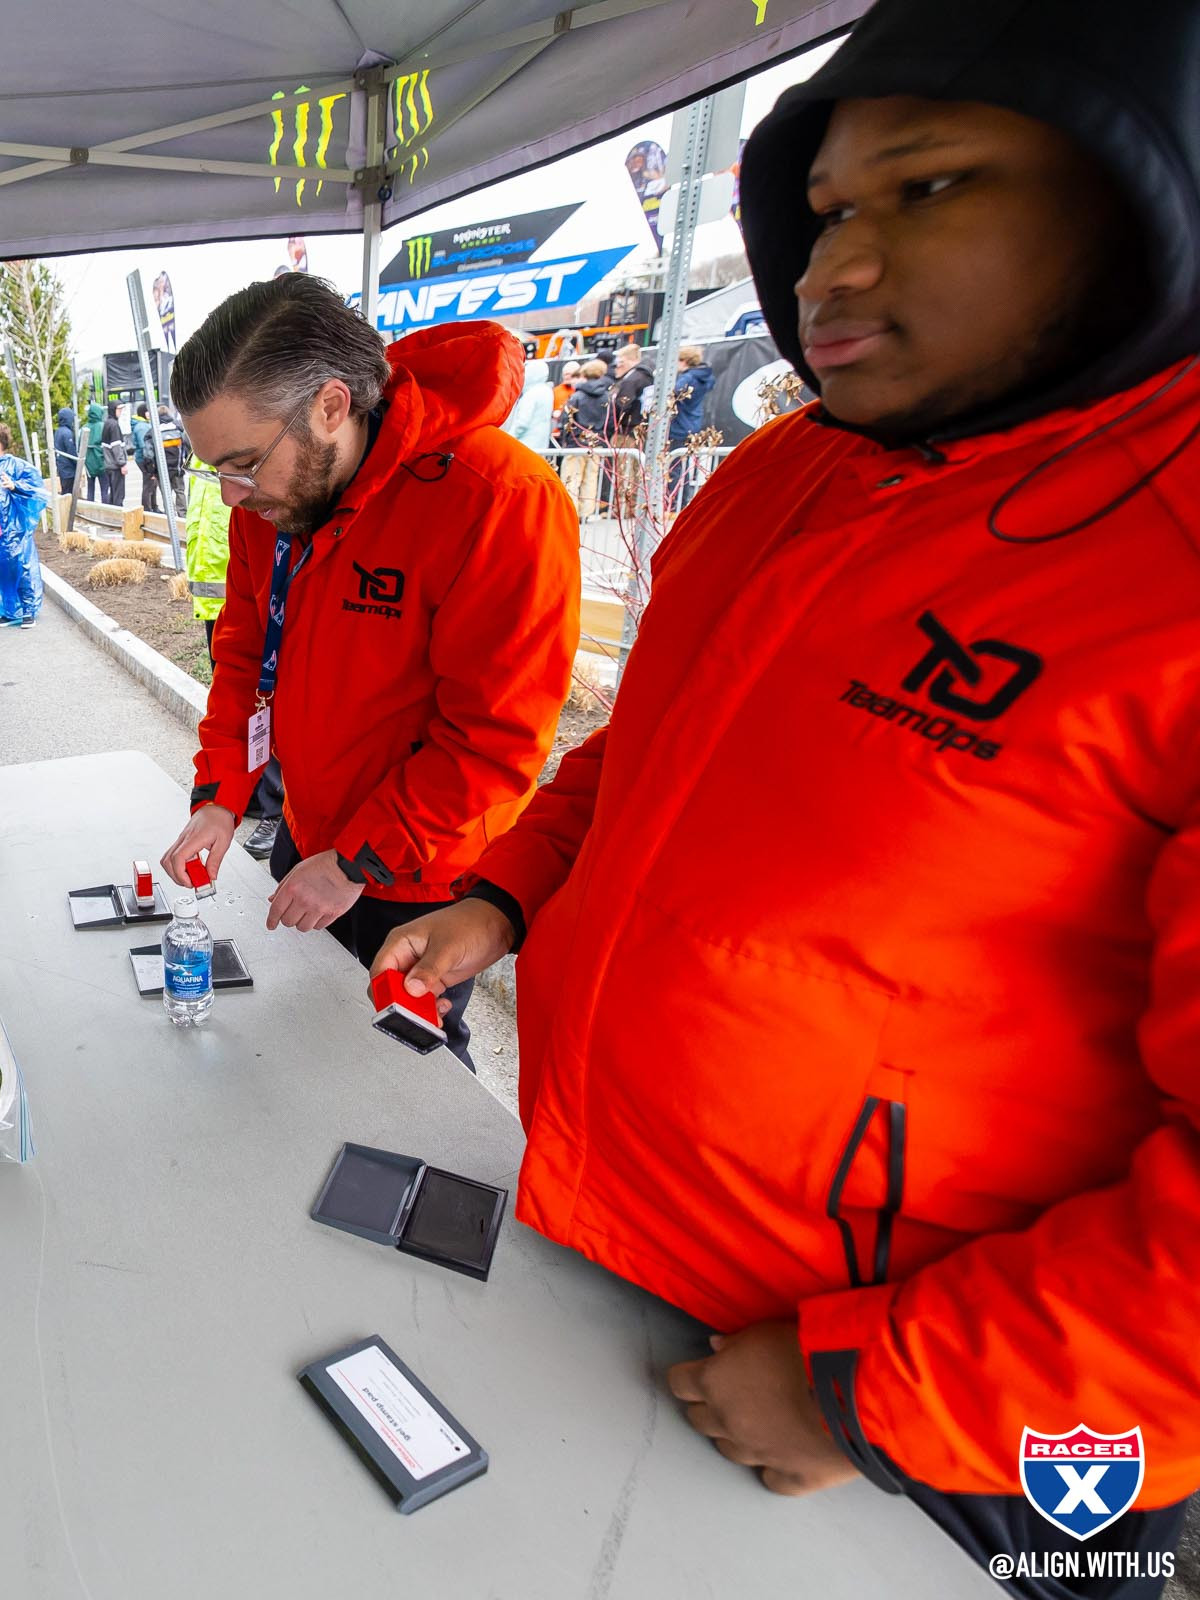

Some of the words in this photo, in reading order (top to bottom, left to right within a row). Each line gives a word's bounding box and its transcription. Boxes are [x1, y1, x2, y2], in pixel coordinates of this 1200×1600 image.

[453, 223, 511, 244] MONSTER
[349, 259, 588, 326] ANFEST
[172, 975, 203, 983] AQUAFINA
[362, 1386, 378, 1403] pad
[376, 1402, 398, 1428] stamp
